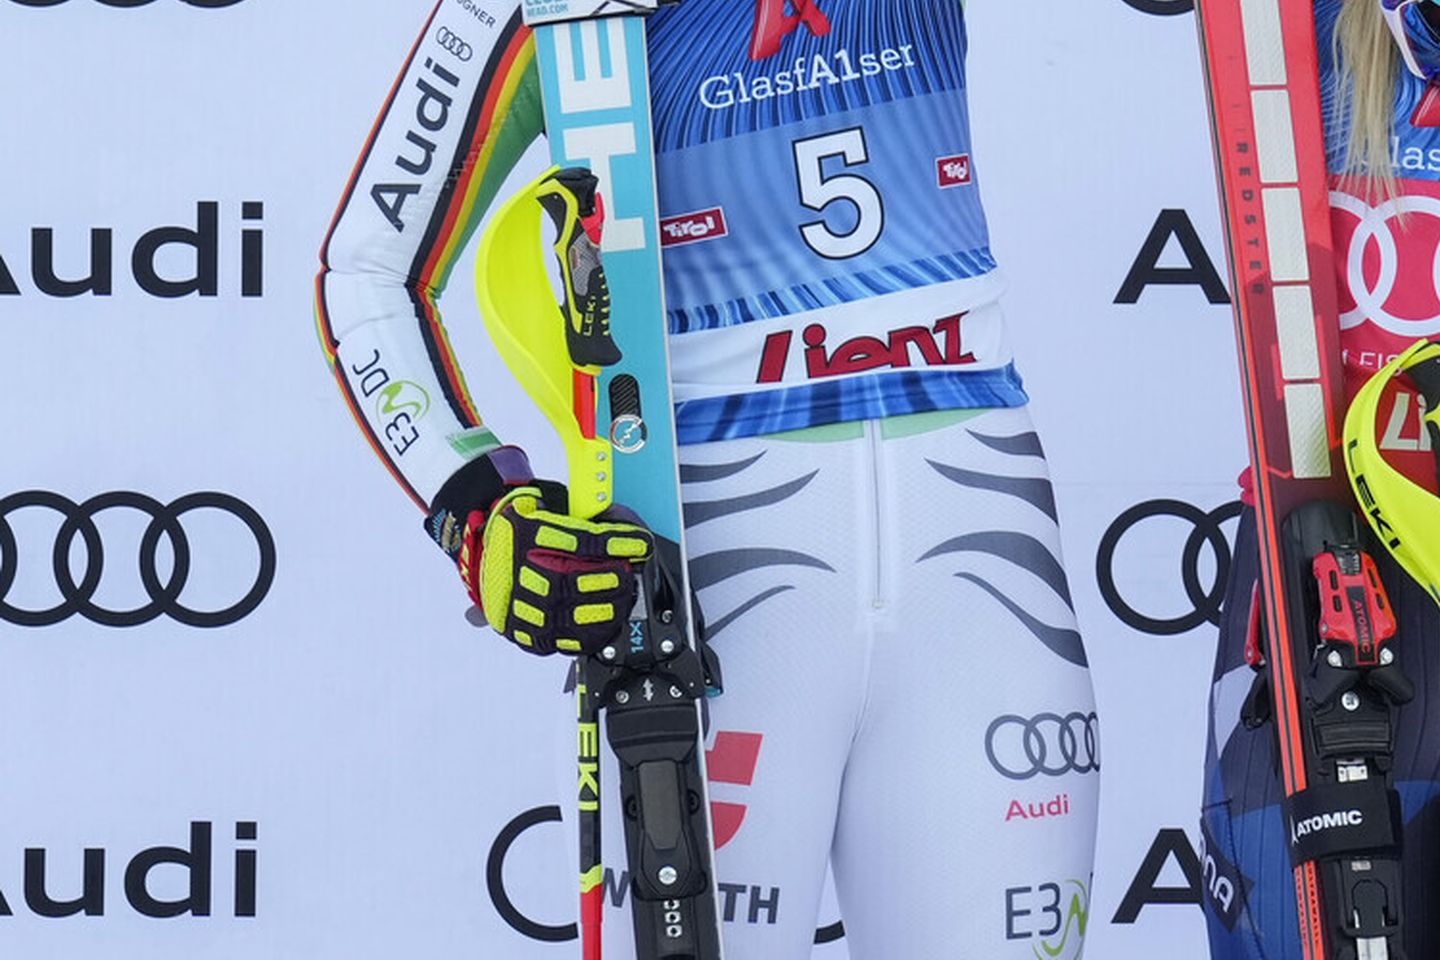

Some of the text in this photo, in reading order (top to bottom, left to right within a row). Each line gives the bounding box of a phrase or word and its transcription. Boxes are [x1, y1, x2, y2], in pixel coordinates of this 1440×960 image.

[701, 44, 914, 109] GlasfA1ser
[371, 58, 460, 233] Audi
[792, 126, 884, 260] 5
[0, 201, 263, 298] udi
[663, 215, 715, 238] Tirol
[1348, 438, 1401, 551] LEKI
[630, 621, 643, 653] 14X
[1354, 601, 1370, 653] ATOMIC
[1005, 794, 1069, 822] Audi
[1296, 810, 1363, 839] ATOMIC
[0, 821, 257, 918] udi
[1006, 882, 1062, 940] E3
